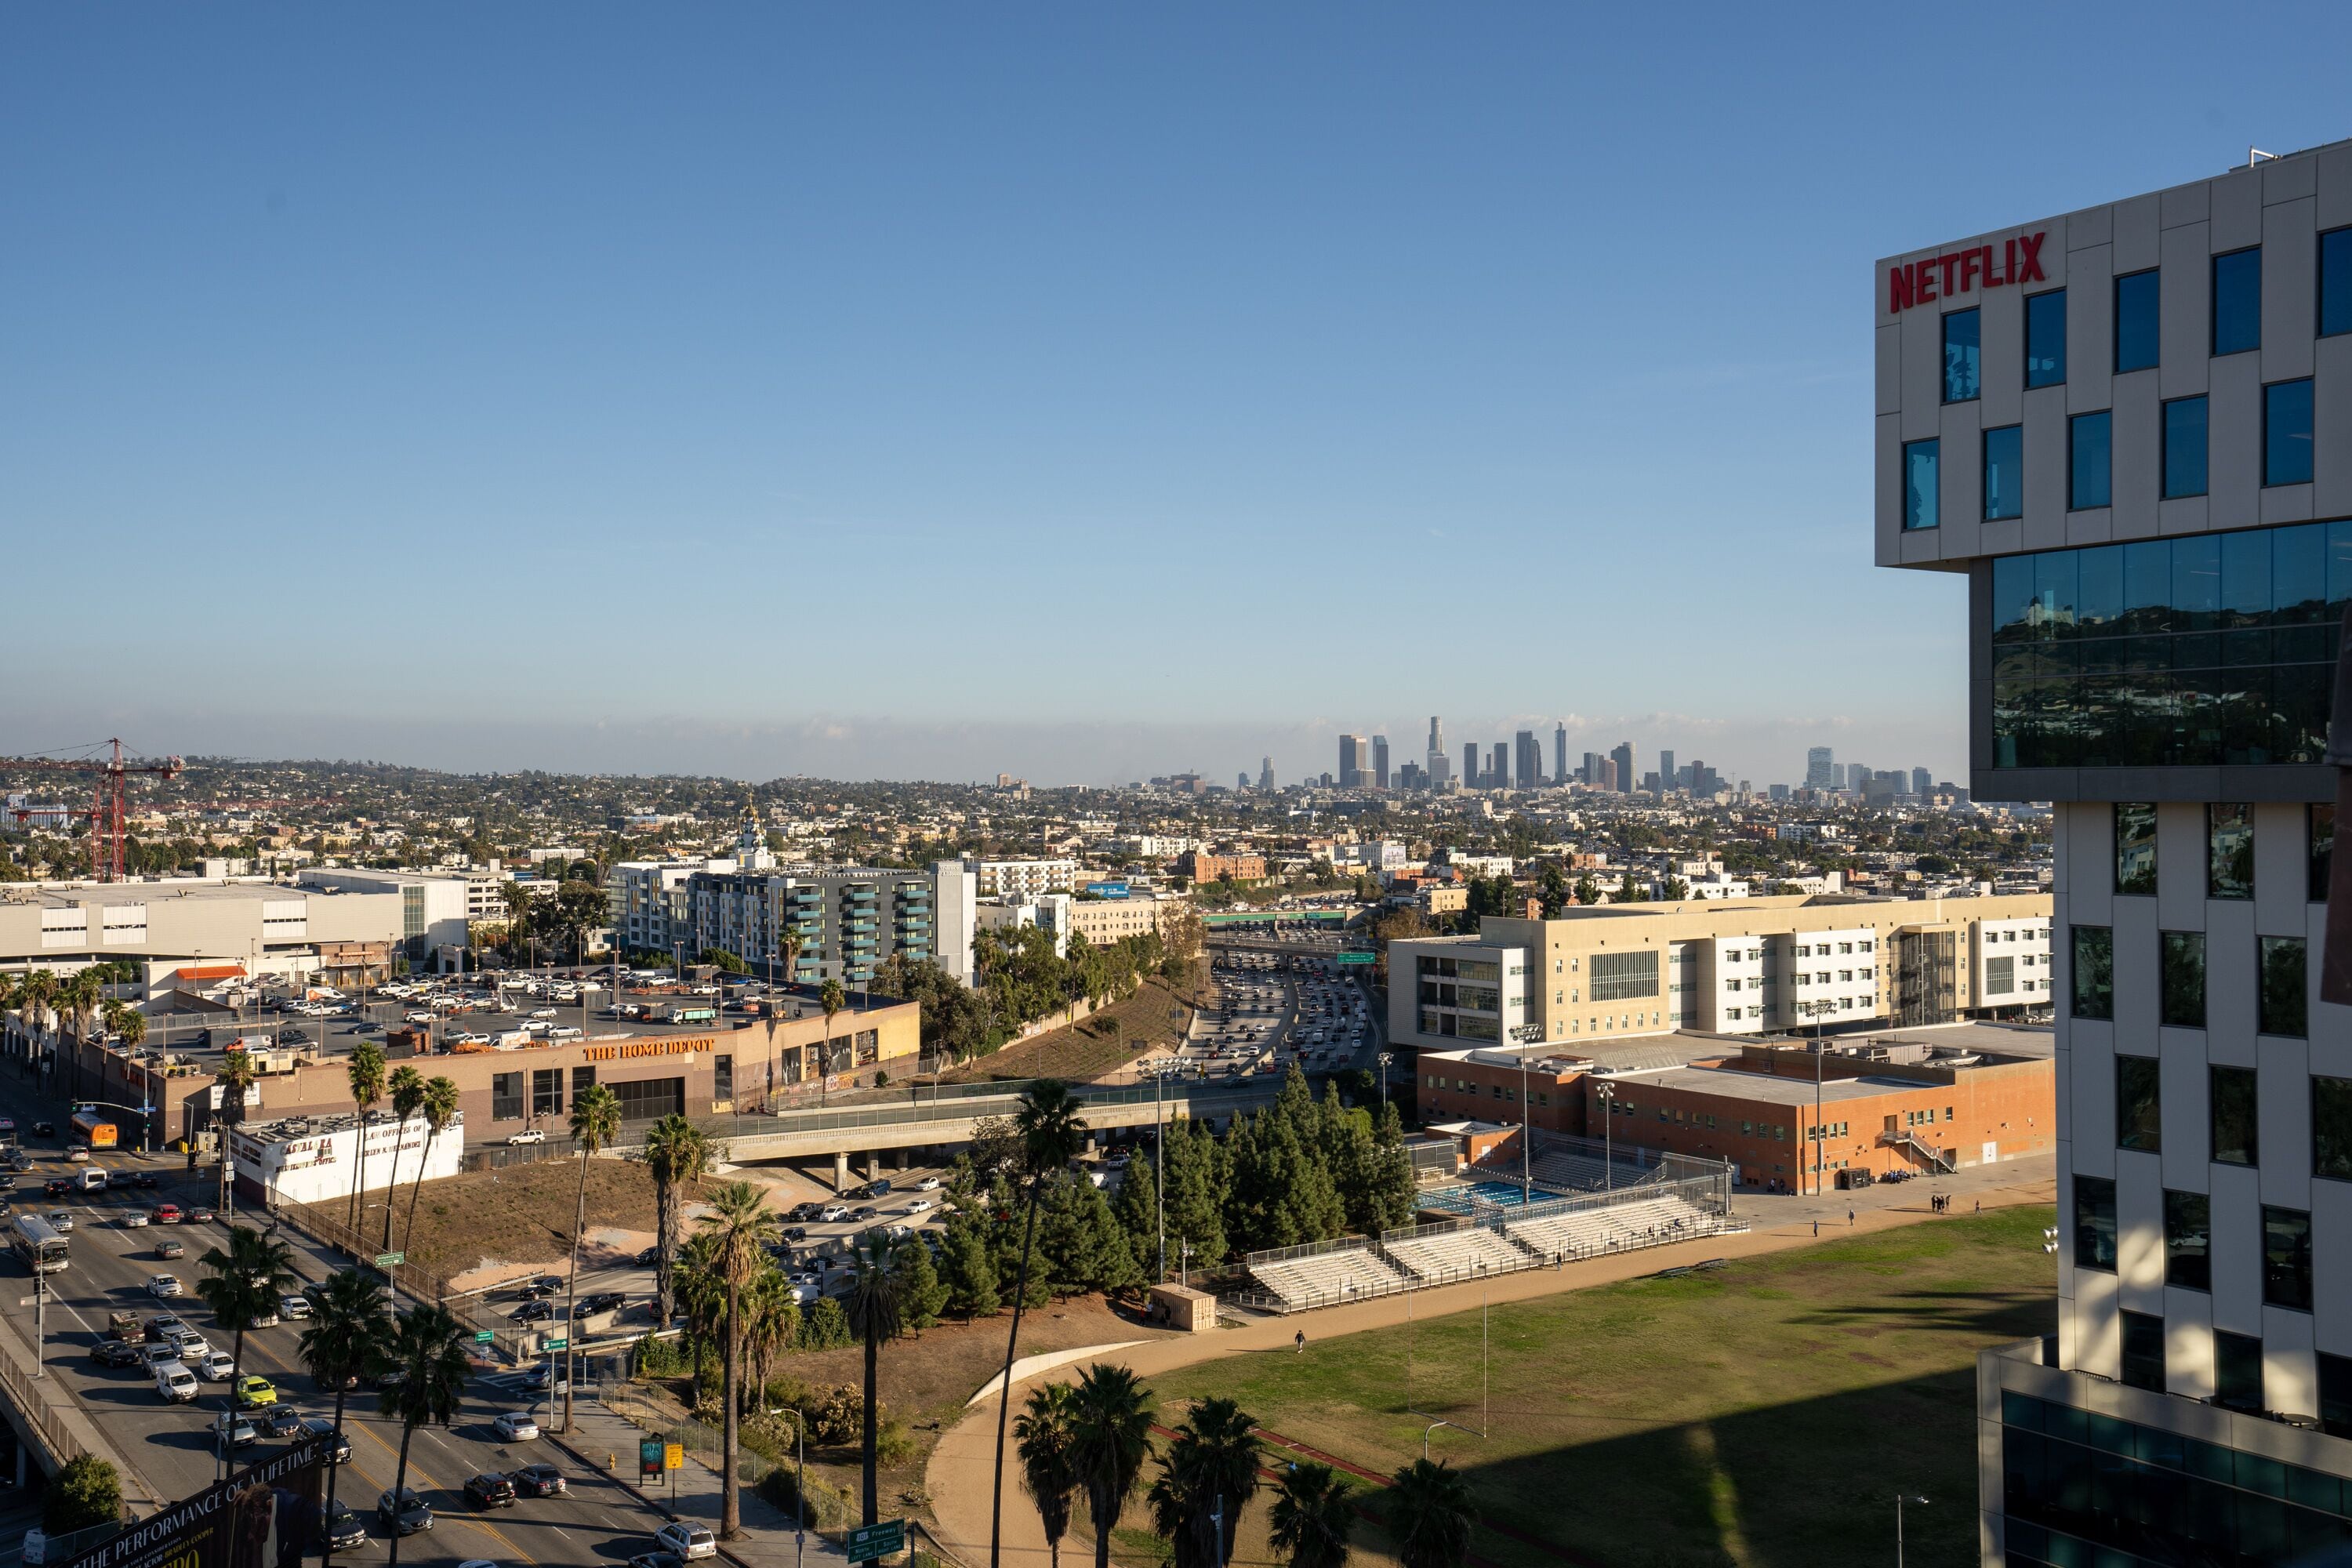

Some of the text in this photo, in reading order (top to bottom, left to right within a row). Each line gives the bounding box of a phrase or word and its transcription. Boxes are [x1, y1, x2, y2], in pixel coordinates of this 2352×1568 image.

[1890, 232, 2045, 314] NETFLIX
[583, 1039, 715, 1061] THE HOME DEPOT
[358, 1148, 381, 1157] ERLYN
[116, 1489, 222, 1560] PERFORMANCE
[226, 1479, 244, 1502] OF
[249, 1474, 256, 1486] A
[143, 1554, 163, 1568] ACTOR
[165, 1540, 190, 1559] BRADLEY
[191, 1527, 214, 1544] COOPER
[858, 1532, 868, 1541] 101
